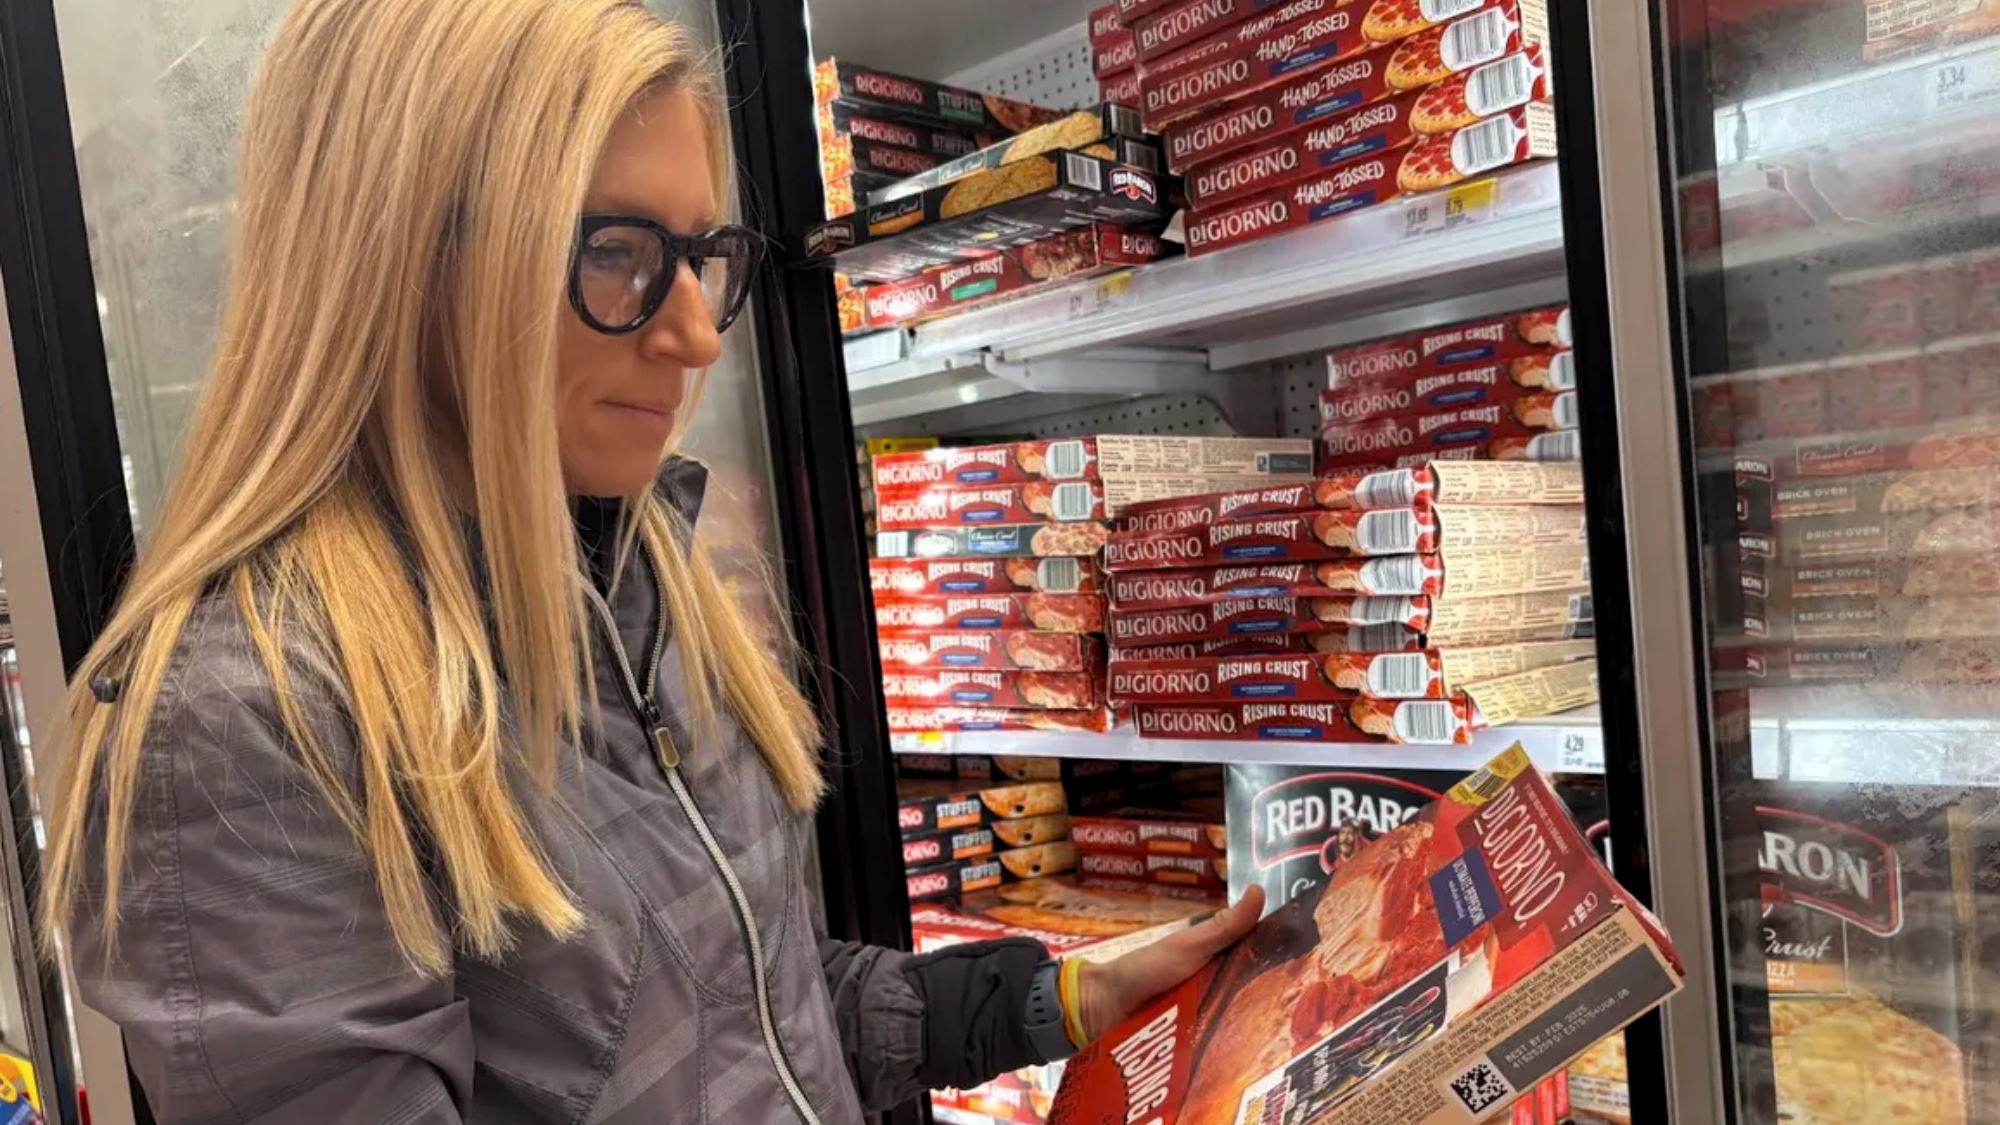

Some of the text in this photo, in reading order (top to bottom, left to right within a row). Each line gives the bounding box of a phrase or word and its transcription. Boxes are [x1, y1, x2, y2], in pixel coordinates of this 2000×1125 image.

[1142, 0, 1233, 50] DIGIORNO
[1147, 60, 1249, 111] DIGIORNO
[1257, 11, 1350, 61] HAND-TOSSED
[855, 75, 923, 104] DIGIORNO
[1173, 107, 1275, 158] DIGIORNO
[1280, 59, 1373, 108] HAND-TOSSED
[850, 121, 917, 148] DIGIORNO
[1198, 148, 1298, 198] DIGIORNO
[1305, 103, 1397, 152] HAND-TOSSED
[1188, 201, 1289, 246] DIGIORNO
[1294, 162, 1385, 207] HAND-TOSSED
[940, 265, 973, 290] RISING
[974, 257, 1004, 275] CRUST
[1334, 324, 1504, 381] DIGIORNO RISING CRUST
[1324, 367, 1497, 420] DIGIORNO RISING CRUST
[1328, 428, 1414, 457] DIGIORNO
[1419, 413, 1459, 435] RISING
[1460, 406, 1500, 424] CRUST
[877, 465, 943, 486] DIGIORNO
[977, 449, 1007, 468] CRUST
[1438, 445, 1477, 461] CRUST
[983, 490, 1013, 508] CRUST
[1219, 492, 1259, 516] RISING
[1261, 487, 1304, 506] CRUST
[1777, 486, 1848, 501] BRICK OVEN
[1109, 520, 1299, 563] DIGIORNO RISING CRUST
[1806, 526, 1881, 540] BRICK OVEN
[962, 561, 995, 579] CRUST
[1117, 565, 1303, 601] DIGIORNO RISING CRUST
[1798, 567, 1872, 579] BRICK OVEN
[980, 597, 1011, 615] CRUST
[1116, 597, 1297, 638] DIGIORNO RISING CRUST
[1799, 610, 1873, 622] BRICK OVEN
[961, 635, 992, 654] CRUST
[1795, 650, 1868, 662] BRICK OVEN
[971, 672, 1002, 690] CRUST
[1115, 660, 1310, 695] DIGIORNO RISING CRUST
[1142, 704, 1334, 735] DIGIORNO RISING CRUST
[1073, 827, 1136, 845] DIGIORNO
[1265, 796, 1325, 845] RED
[1475, 785, 1566, 924] DIGIORNO
[1110, 1004, 1178, 1124] RISING
